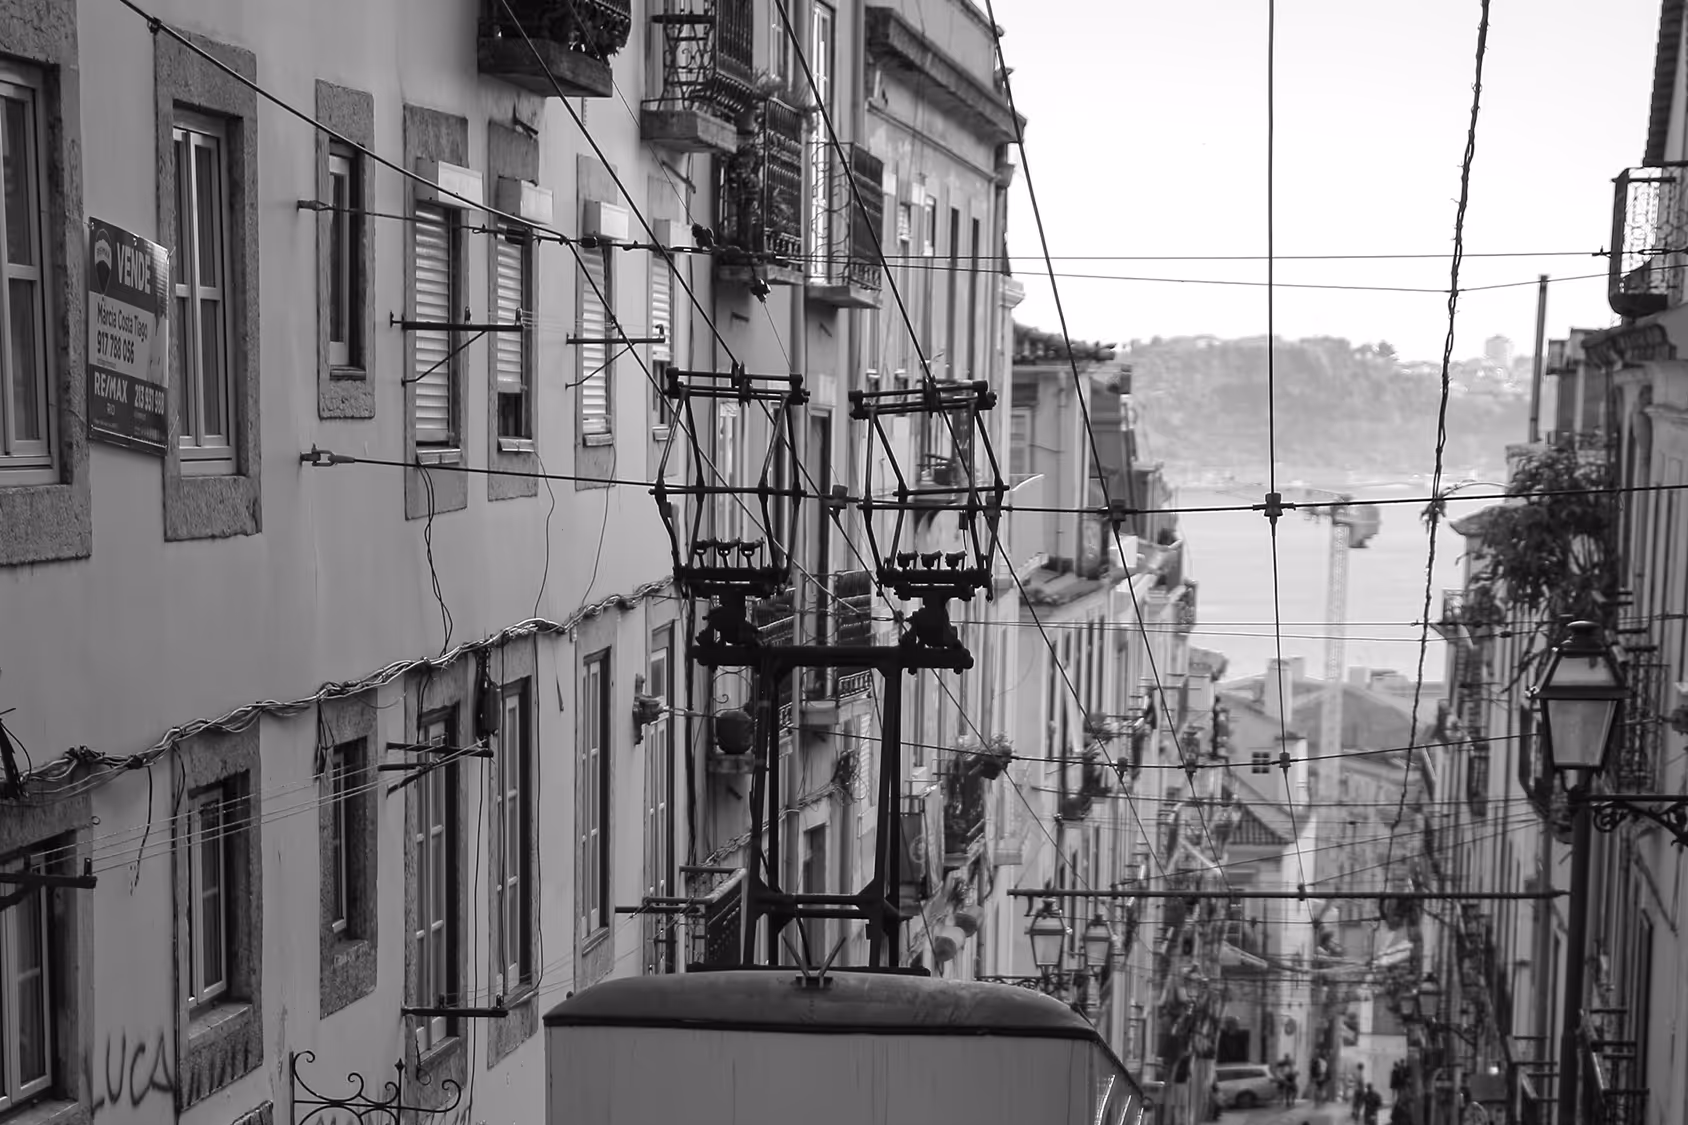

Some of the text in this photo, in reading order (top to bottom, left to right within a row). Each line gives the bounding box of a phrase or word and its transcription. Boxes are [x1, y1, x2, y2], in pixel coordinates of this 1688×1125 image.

[116, 242, 151, 294] VENDE
[118, 308, 133, 334] Costa
[134, 315, 148, 343] Tiago
[97, 330, 109, 356] 917
[94, 370, 129, 404] RE/MAX
[134, 384, 144, 409] 213
